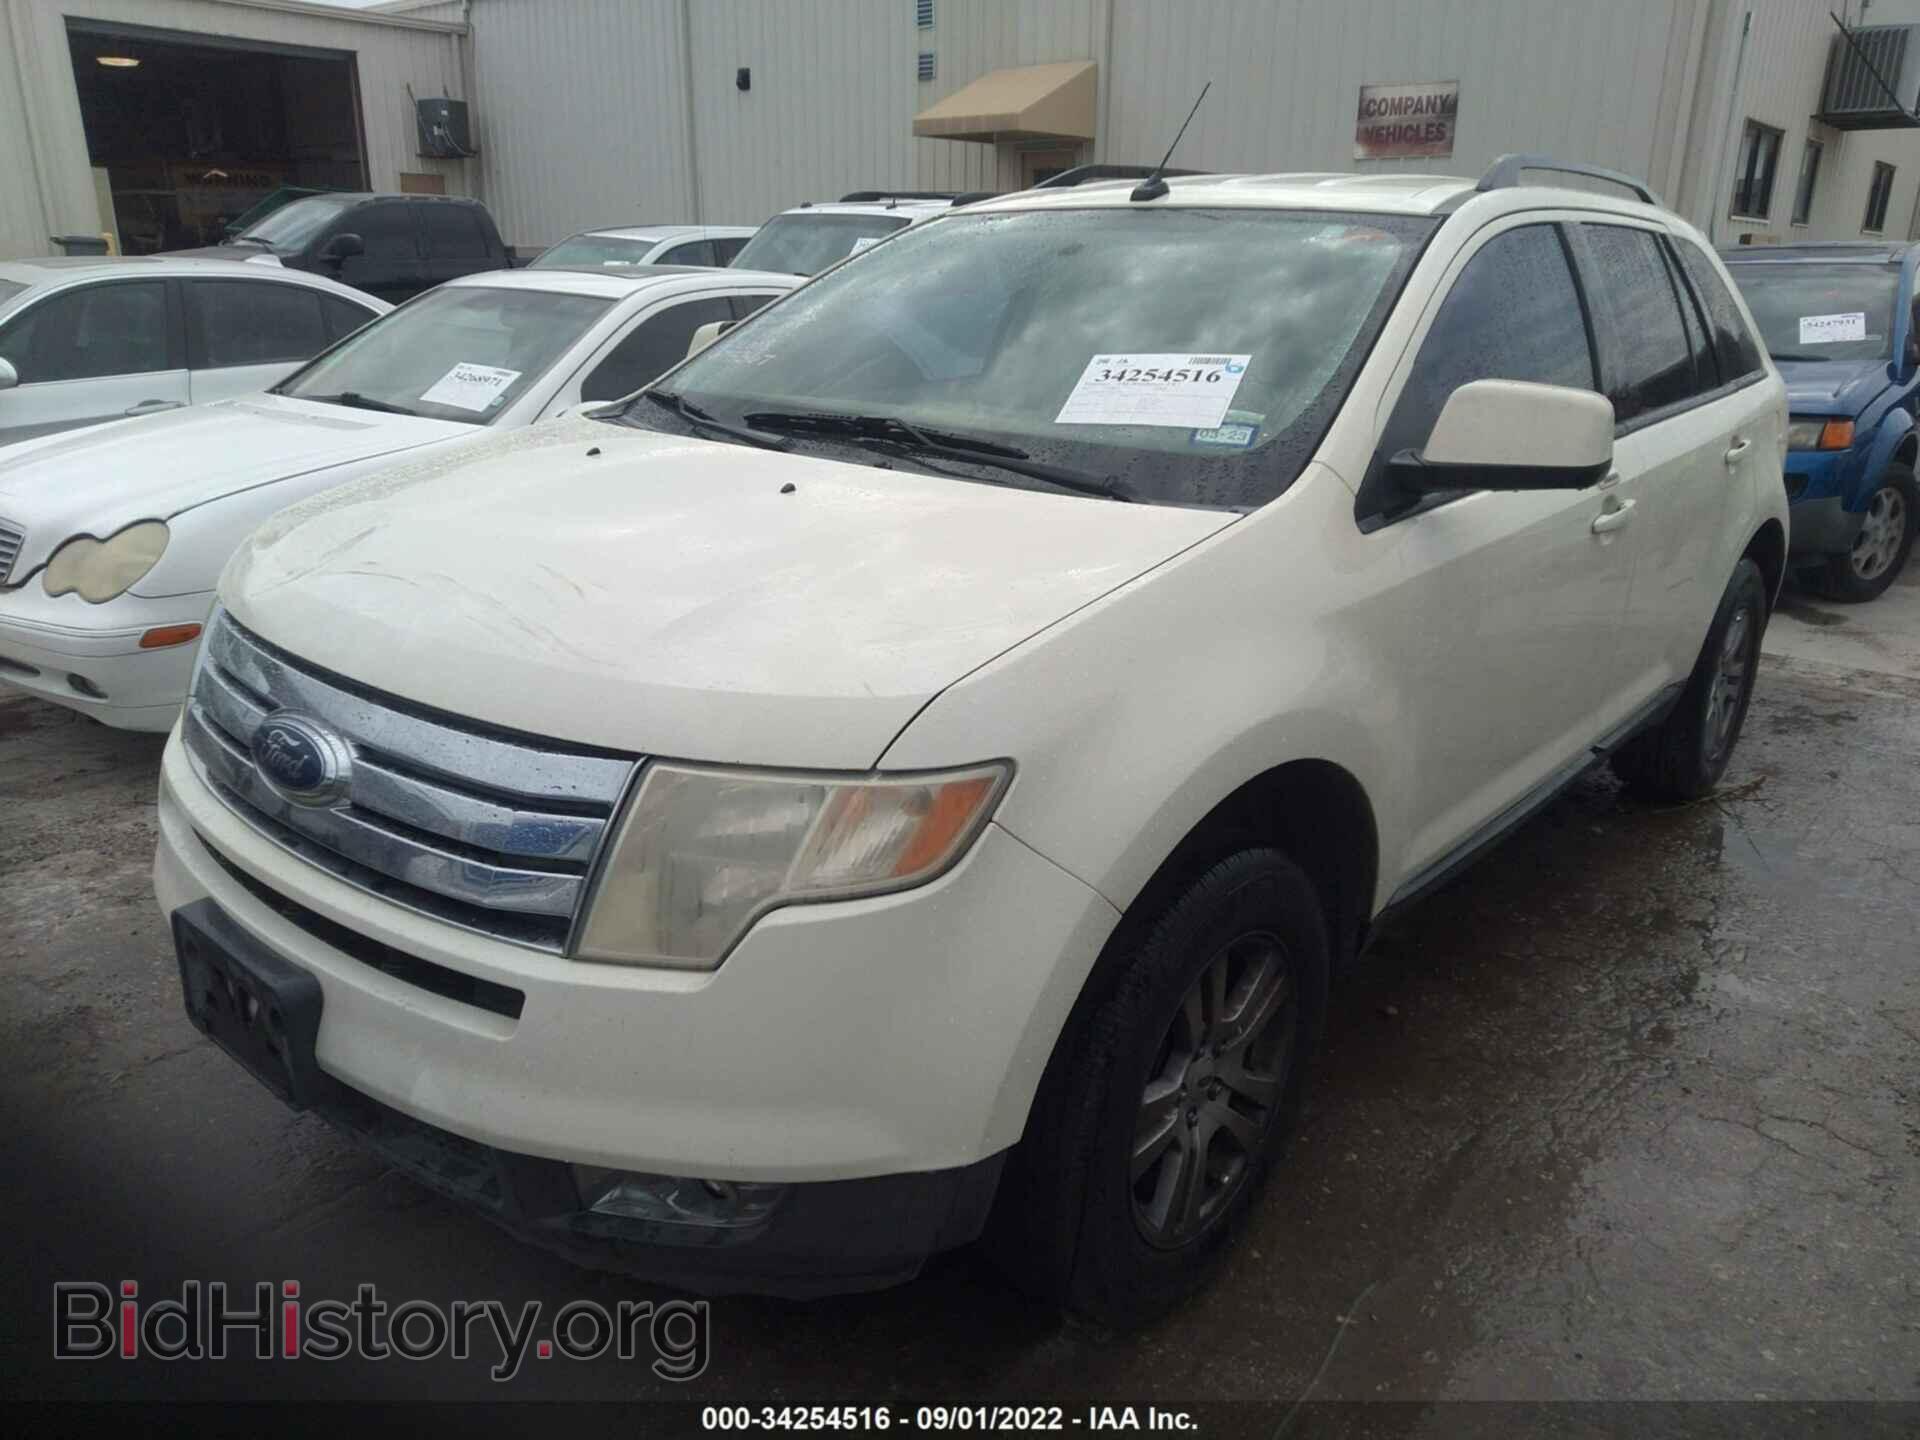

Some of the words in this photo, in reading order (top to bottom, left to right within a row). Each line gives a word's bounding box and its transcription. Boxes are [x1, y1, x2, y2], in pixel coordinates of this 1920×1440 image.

[1366, 94, 1451, 117] COMPANY
[1363, 122, 1447, 144] VEHICLES
[1095, 368, 1222, 384] 34254516
[262, 729, 311, 778] Ford
